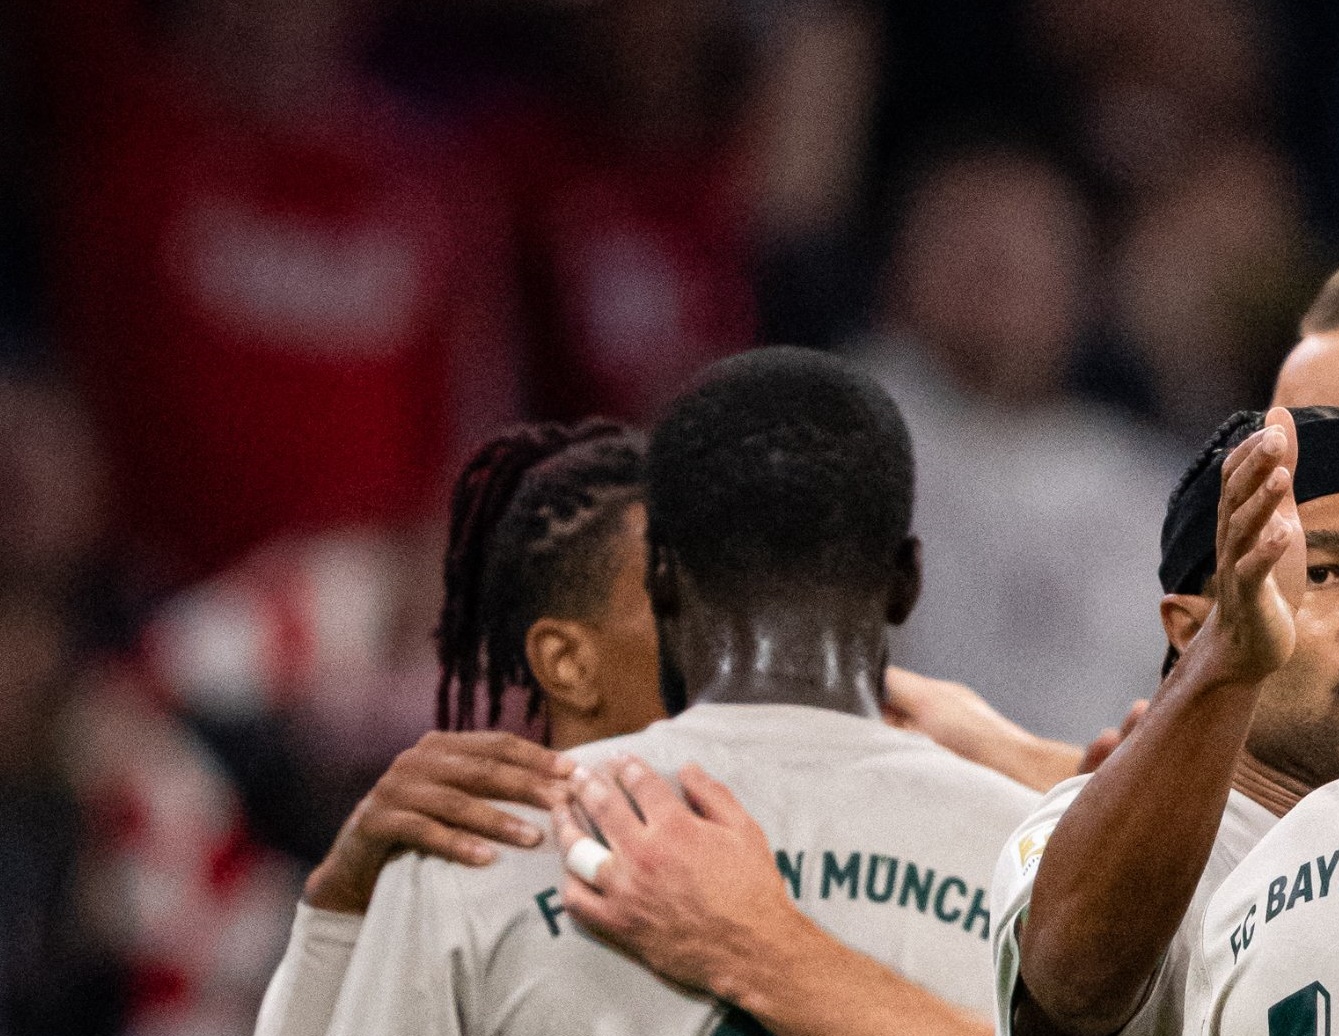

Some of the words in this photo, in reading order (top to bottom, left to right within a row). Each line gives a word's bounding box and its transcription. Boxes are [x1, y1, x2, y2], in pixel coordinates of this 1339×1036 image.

[534, 887, 566, 937] F
[820, 850, 990, 940] MÜNCH
[1230, 905, 1256, 964] FC
